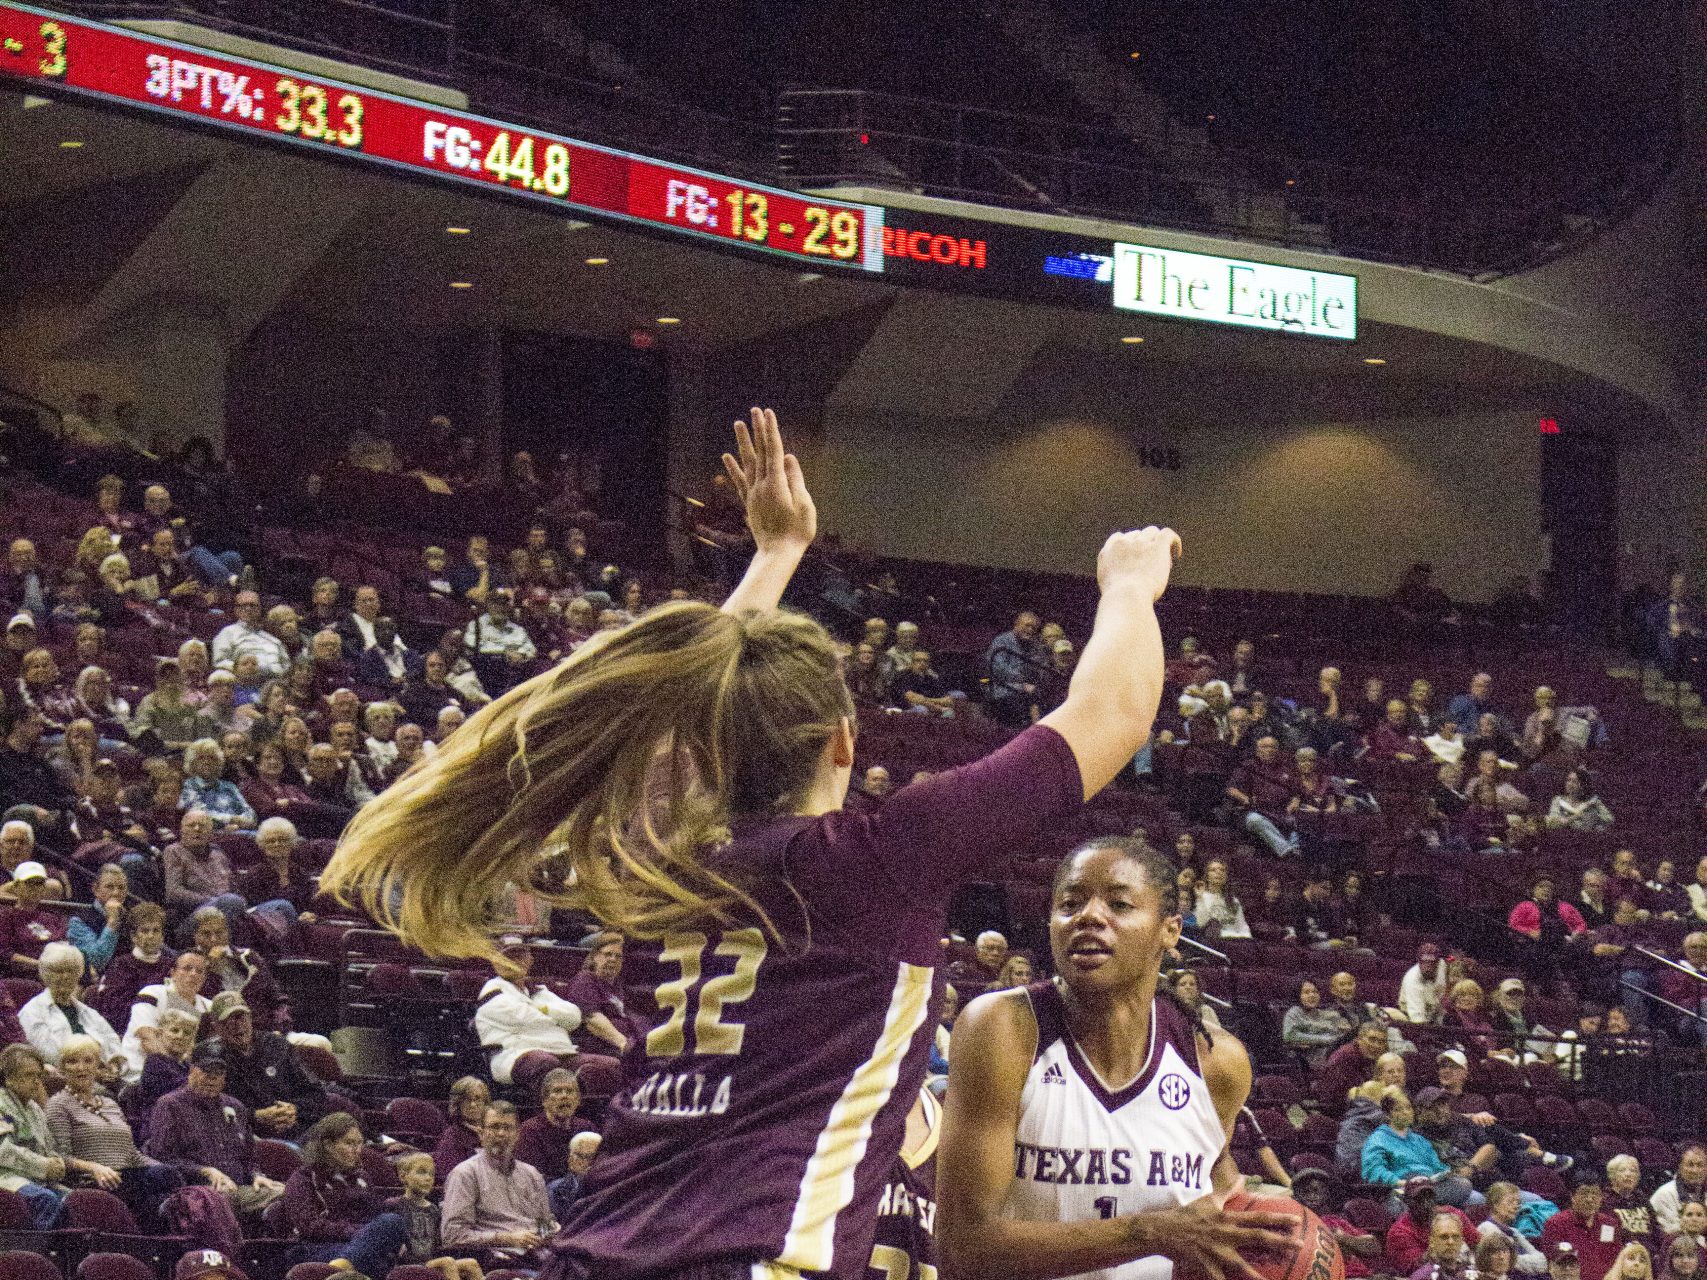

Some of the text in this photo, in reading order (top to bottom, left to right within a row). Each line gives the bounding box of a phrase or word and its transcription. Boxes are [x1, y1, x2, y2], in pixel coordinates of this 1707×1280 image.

[39, 22, 67, 77] 3
[145, 54, 364, 147] 3PT%: 33.3
[484, 132, 571, 196] 44.8
[665, 179, 718, 227] FG:
[726, 190, 769, 243] 13
[803, 207, 859, 259] 29
[1123, 250, 1209, 310] The
[1227, 265, 1345, 333] Eagle
[646, 928, 768, 1056] 32
[1159, 1074, 1190, 1110] SEC
[1015, 1142, 1205, 1189] TEXAS A&M
